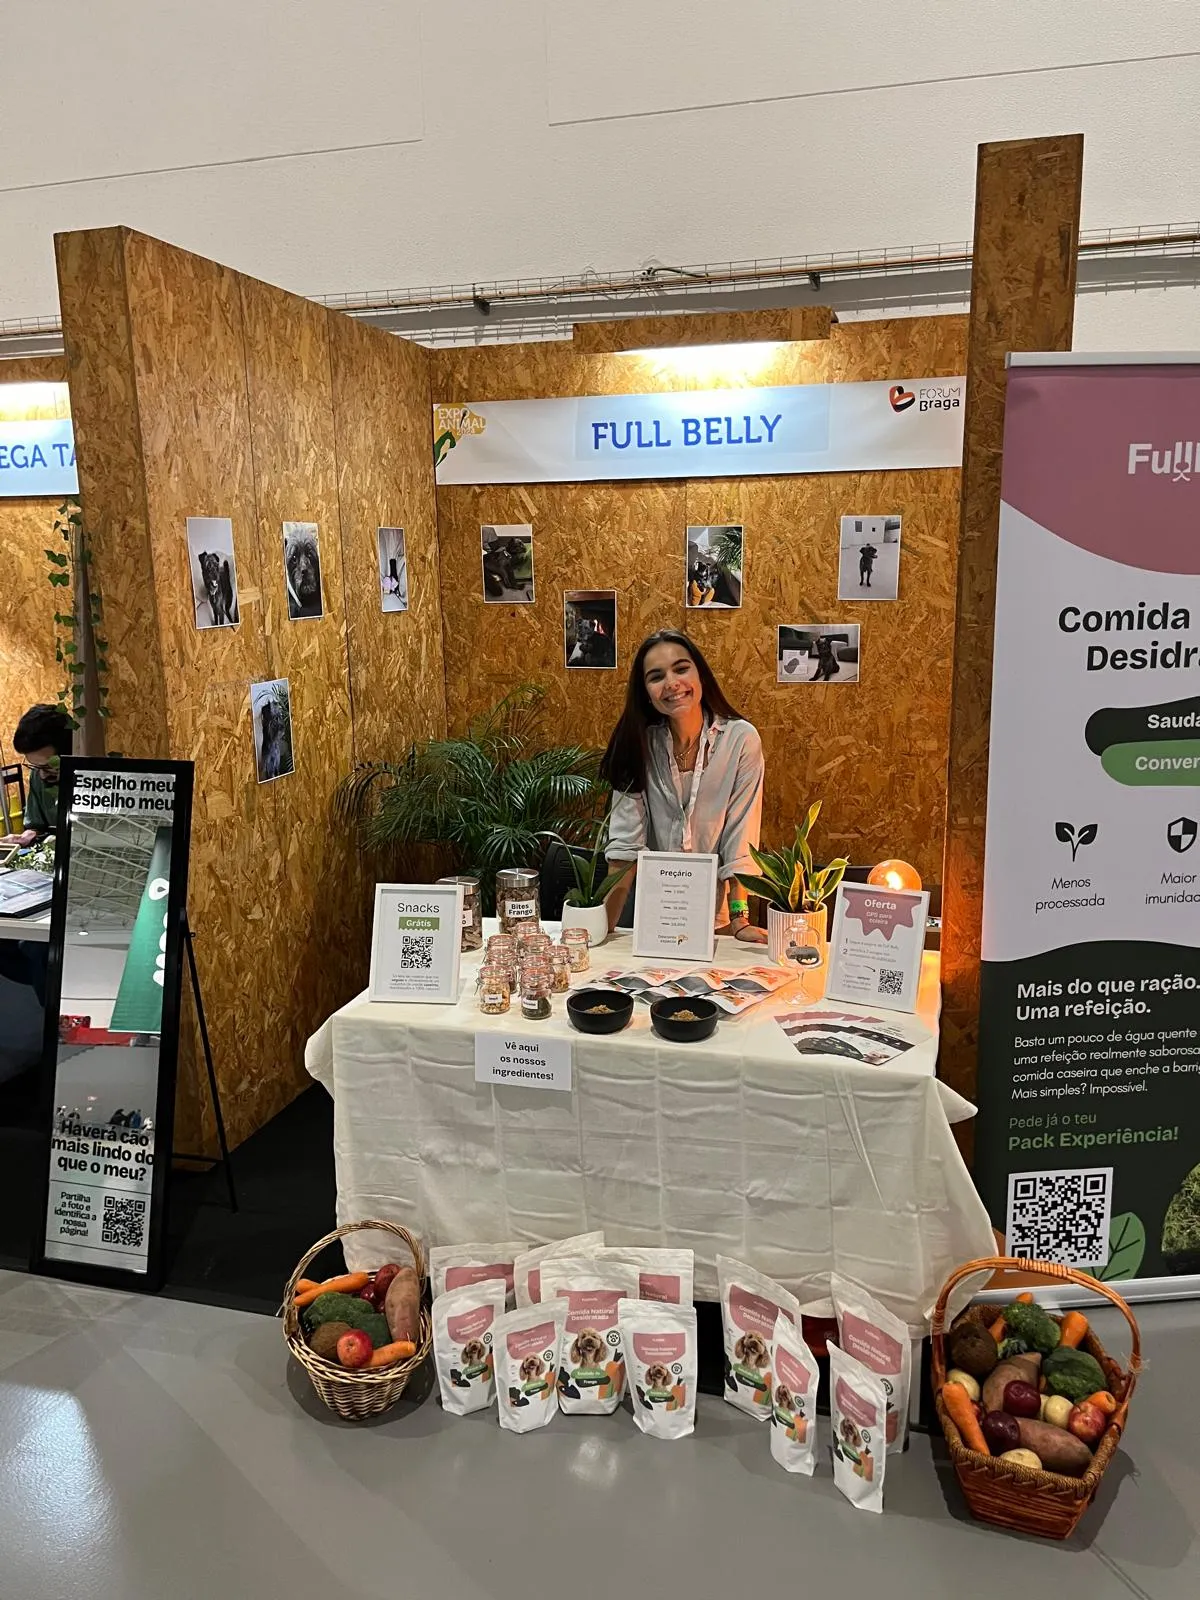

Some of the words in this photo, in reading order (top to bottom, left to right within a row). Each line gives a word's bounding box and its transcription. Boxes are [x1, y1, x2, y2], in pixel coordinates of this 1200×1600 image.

[920, 387, 960, 399] FORUM
[920, 398, 960, 412] Braga
[438, 407, 469, 420] EXPO
[438, 417, 486, 430] ANIMAL
[591, 420, 671, 450] FULL
[681, 414, 782, 447] BELLY
[1127, 440, 1200, 475] Full
[1058, 602, 1190, 633] Comida
[1086, 640, 1200, 671] Desidr
[75, 774, 137, 791] Espelho
[140, 779, 175, 793] meu
[73, 793, 136, 809] espelho
[138, 797, 174, 811] meu
[660, 869, 692, 878] Preçário
[1160, 872, 1197, 884] Maior
[1051, 877, 1091, 890] Menos
[397, 902, 440, 913] Snacks
[864, 899, 897, 910] Oferta
[1035, 893, 1105, 914] processada
[508, 909, 533, 917] Frango
[406, 919, 432, 927] Grátis
[1017, 980, 1063, 999] Mais
[1067, 978, 1092, 995] do
[1097, 979, 1135, 996] que
[1140, 973, 1200, 995] ração.
[1016, 1004, 1060, 1020] Uma
[1064, 998, 1151, 1019] refeição.
[1014, 1036, 1045, 1048] Basta
[1048, 1036, 1065, 1045] um
[1067, 1034, 1104, 1047] pouco
[1107, 1029, 1122, 1042] de
[1125, 1030, 1155, 1044] água
[1157, 1027, 1197, 1042] quente
[504, 1041, 517, 1050] Vê
[518, 1043, 539, 1053] aqui
[500, 1055, 511, 1063] os
[513, 1056, 546, 1066] nossos
[1013, 1055, 1038, 1065] uma
[1040, 1050, 1087, 1064] refeição
[1089, 1047, 1147, 1060] realmente
[492, 1066, 554, 1081] ingredientes!
[1012, 1067, 1054, 1082] comida
[1056, 1067, 1098, 1079] caseira
[1100, 1067, 1122, 1080] que
[1125, 1062, 1160, 1075] enche
[1162, 1065, 1170, 1074] a
[1011, 1087, 1038, 1100] Mais
[1039, 1082, 1087, 1099] simples?
[1089, 1080, 1148, 1097] Impossível.
[1009, 1115, 1042, 1129] Pede
[1045, 1112, 1058, 1129] já
[1062, 1115, 1070, 1125] o
[1075, 1113, 1097, 1125] teu
[61, 1119, 117, 1142] Haverá
[120, 1130, 149, 1147] cão
[1008, 1132, 1055, 1151] Pack
[1060, 1126, 1179, 1150] Experiência!
[51, 1137, 90, 1154] mais
[92, 1141, 132, 1162] lindo
[134, 1149, 155, 1166] do
[57, 1156, 88, 1172] que
[90, 1162, 101, 1174] o
[103, 1163, 147, 1181] meu?
[60, 1191, 91, 1203] Partilha
[67, 1200, 84, 1211] foto
[63, 1218, 87, 1228] nossa
[60, 1226, 89, 1237] página!
